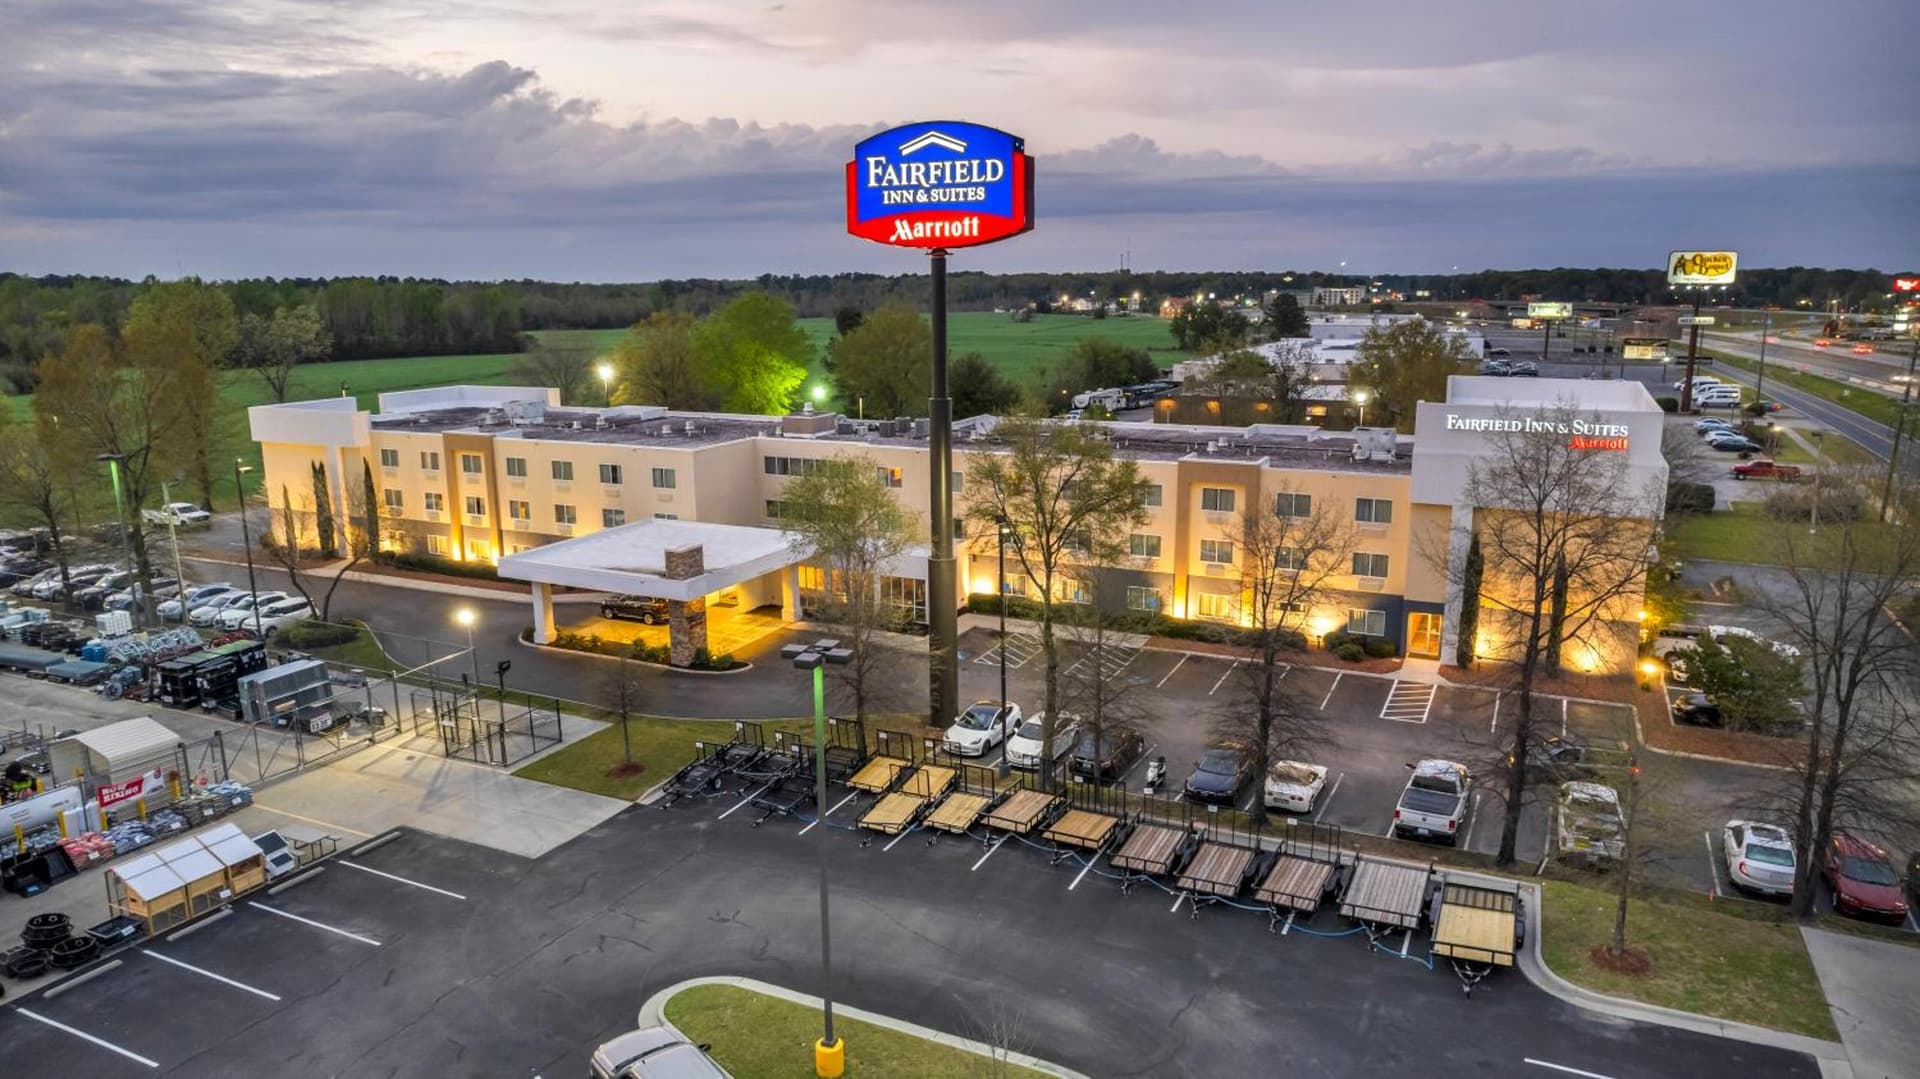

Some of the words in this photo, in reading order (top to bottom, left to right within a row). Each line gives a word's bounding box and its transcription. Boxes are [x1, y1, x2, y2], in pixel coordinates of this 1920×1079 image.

[866, 156, 1004, 187] FAIRFIELD
[889, 216, 980, 242] Marriott
[1446, 414, 1522, 432] FAIRFIELD
[1525, 417, 1554, 433] INN
[1557, 423, 1569, 434] &
[1572, 419, 1629, 437] SUITES
[1568, 436, 1628, 450] Marriott
